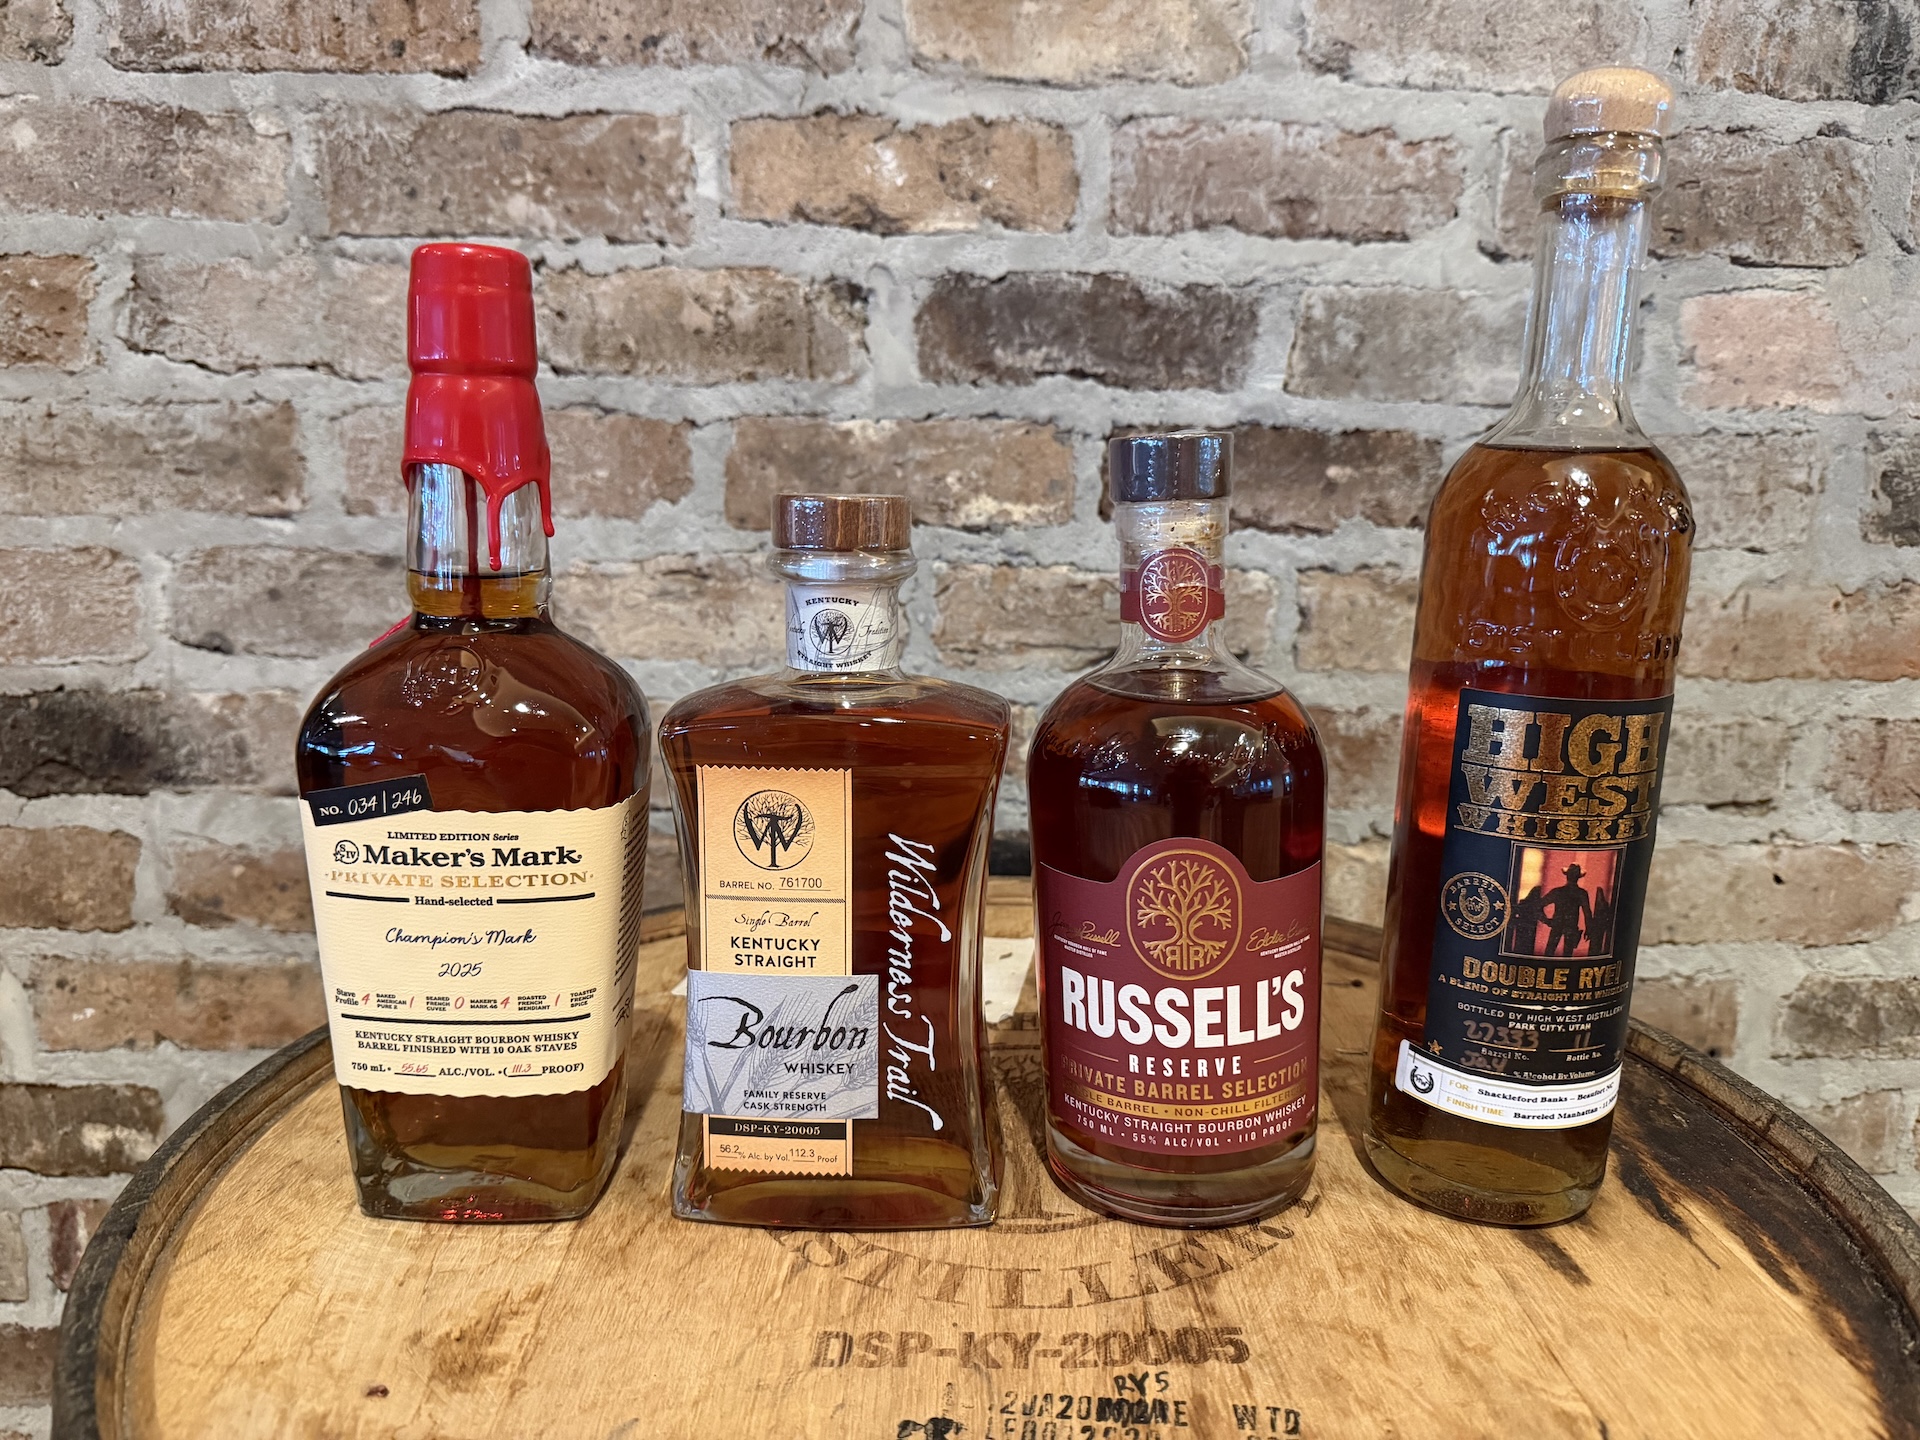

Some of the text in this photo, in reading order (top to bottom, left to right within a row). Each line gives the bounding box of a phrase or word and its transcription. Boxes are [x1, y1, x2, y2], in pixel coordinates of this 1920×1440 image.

[805, 597, 860, 607] KENTUCKY
[796, 650, 834, 669] STRAIGHT
[1462, 703, 1666, 777] HIGH
[1460, 763, 1658, 817] WEST
[319, 805, 343, 817] NO.
[1456, 804, 1652, 841] WHISKEY
[387, 831, 519, 841] LIMITED EDITION Series
[362, 843, 583, 867] Maker's Mark
[330, 869, 589, 889] PRIVATE SELECTION
[719, 876, 823, 891] BARREL NO. 761700
[1449, 877, 1496, 894] BARREL
[414, 895, 494, 907] Hand-selected
[734, 910, 820, 933] Single Barrel
[1454, 916, 1501, 934] SELECT
[385, 927, 538, 950] Champion's Mark
[730, 935, 821, 952] KENTUCKY
[734, 953, 817, 969] STRAIGHT
[438, 961, 483, 978] 2025
[1462, 955, 1623, 990] DOUBLE RYE!
[882, 832, 952, 1132] Wilderness Trail
[1438, 973, 1447, 983] A
[1449, 976, 1489, 993] BLEND
[1491, 986, 1509, 996] OF
[1510, 989, 1571, 1002] STRAIGHT
[1572, 991, 1593, 1001] RYE
[334, 994, 359, 1006] Profile
[336, 987, 357, 998] Stave
[360, 992, 371, 1006] 4
[517, 994, 547, 1002] ROASTED
[569, 987, 598, 998] TOASTED
[570, 993, 595, 1003] FRENCH
[376, 998, 407, 1006] AMERICAN
[500, 995, 511, 1010] 4
[517, 1004, 551, 1012] MENDIANT
[570, 1000, 589, 1008] SPICE
[1061, 965, 1306, 1049] RUSSELL'S
[697, 984, 869, 1051] Bourbon
[1457, 1001, 1625, 1023] BOTTLED BY HIGH WEST DISTILLERY
[1508, 1021, 1536, 1031] PARK
[1568, 1022, 1592, 1032] UTAH
[354, 1030, 580, 1045] KENTUCKY STRAIGHT BOURBON WHISKY
[357, 1040, 578, 1054] BARREL FINISHED WITH 10 OAK STAVES
[1481, 1047, 1530, 1061] Barrel No.
[1565, 1052, 1590, 1062] Bottle
[351, 1061, 368, 1071] 750
[400, 1062, 430, 1074] 55.65
[438, 1067, 495, 1077] ALC./VOL.
[783, 1062, 855, 1075] WHISKEY
[1128, 1053, 1242, 1079] RESERVE
[1061, 1054, 1308, 1101] PRIVATE BARREL SELECTION
[1523, 1071, 1556, 1080] Alcohol
[1557, 1072, 1568, 1081] By
[1568, 1070, 1596, 1080] Volume
[743, 1089, 827, 1101] FAMILY RESERVE
[1448, 1078, 1470, 1092] FOR
[1477, 1087, 1538, 1104] Shackleford
[743, 1101, 828, 1112] CASK STRENGTH
[1063, 1092, 1120, 1124] KENTUCKY
[1123, 1116, 1193, 1134] STRAIGHT
[1198, 1115, 1262, 1134] BOURBON
[1264, 1094, 1307, 1123] WHISKEY
[1106, 1097, 1159, 1115] BARREL
[1174, 1103, 1250, 1118] NON-CHILL
[1445, 1095, 1478, 1112] FINISH
[1480, 1105, 1505, 1117] TIME
[1513, 1111, 1555, 1120] Barreled
[1557, 1106, 1599, 1119] Manhattan
[733, 1122, 821, 1136] DSP-KY-20005
[1076, 1113, 1293, 1149] 750 ML 55% ALC/VOL 110 PROOF
[747, 1152, 762, 1161] Alc.
[764, 1152, 774, 1163] by
[775, 1153, 791, 1162] Vol.
[789, 1148, 816, 1158] 112.3
[817, 1155, 838, 1163] Proof
[810, 1325, 1252, 1370] DSP-KY-20005
